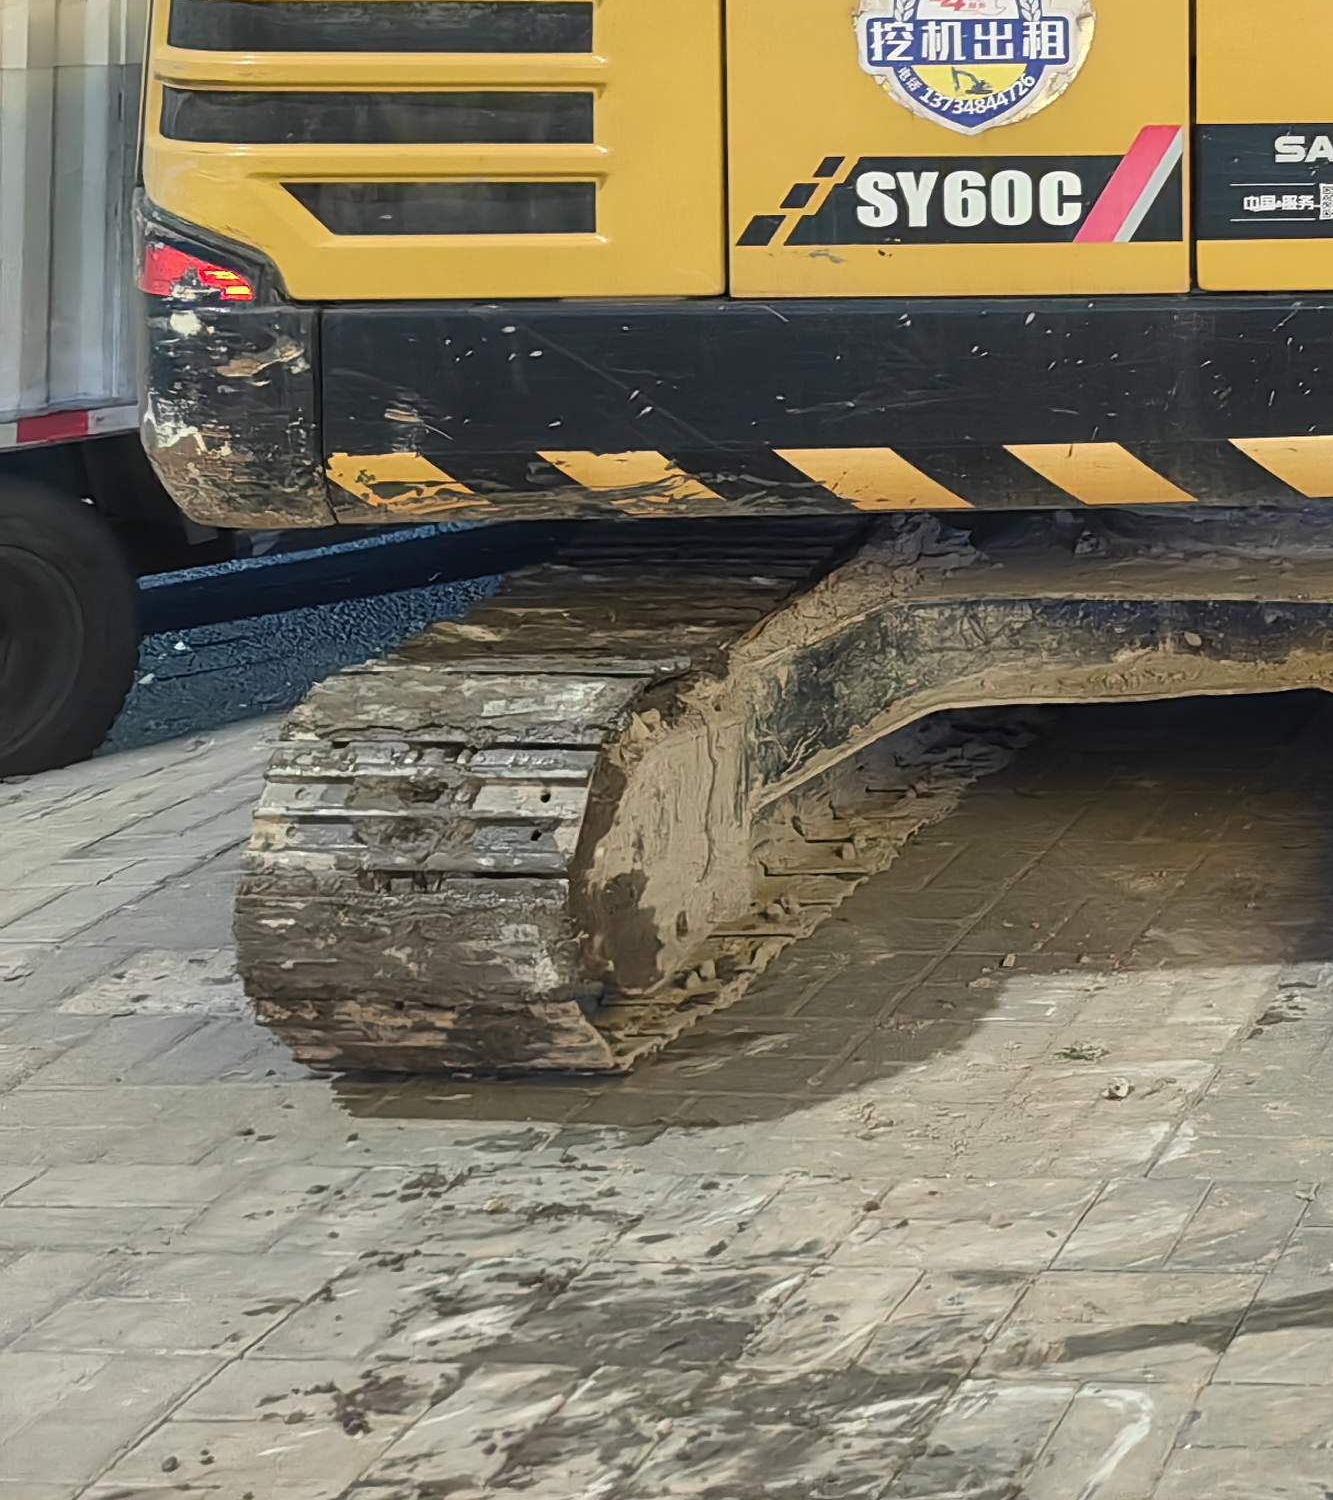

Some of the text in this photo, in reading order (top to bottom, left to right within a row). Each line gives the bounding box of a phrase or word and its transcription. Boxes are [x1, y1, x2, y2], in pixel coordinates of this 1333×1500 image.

[870, 20, 1066, 61] 挖机出租
[897, 66, 1036, 115] 电话 13734844726
[856, 170, 1082, 228] SY60C
